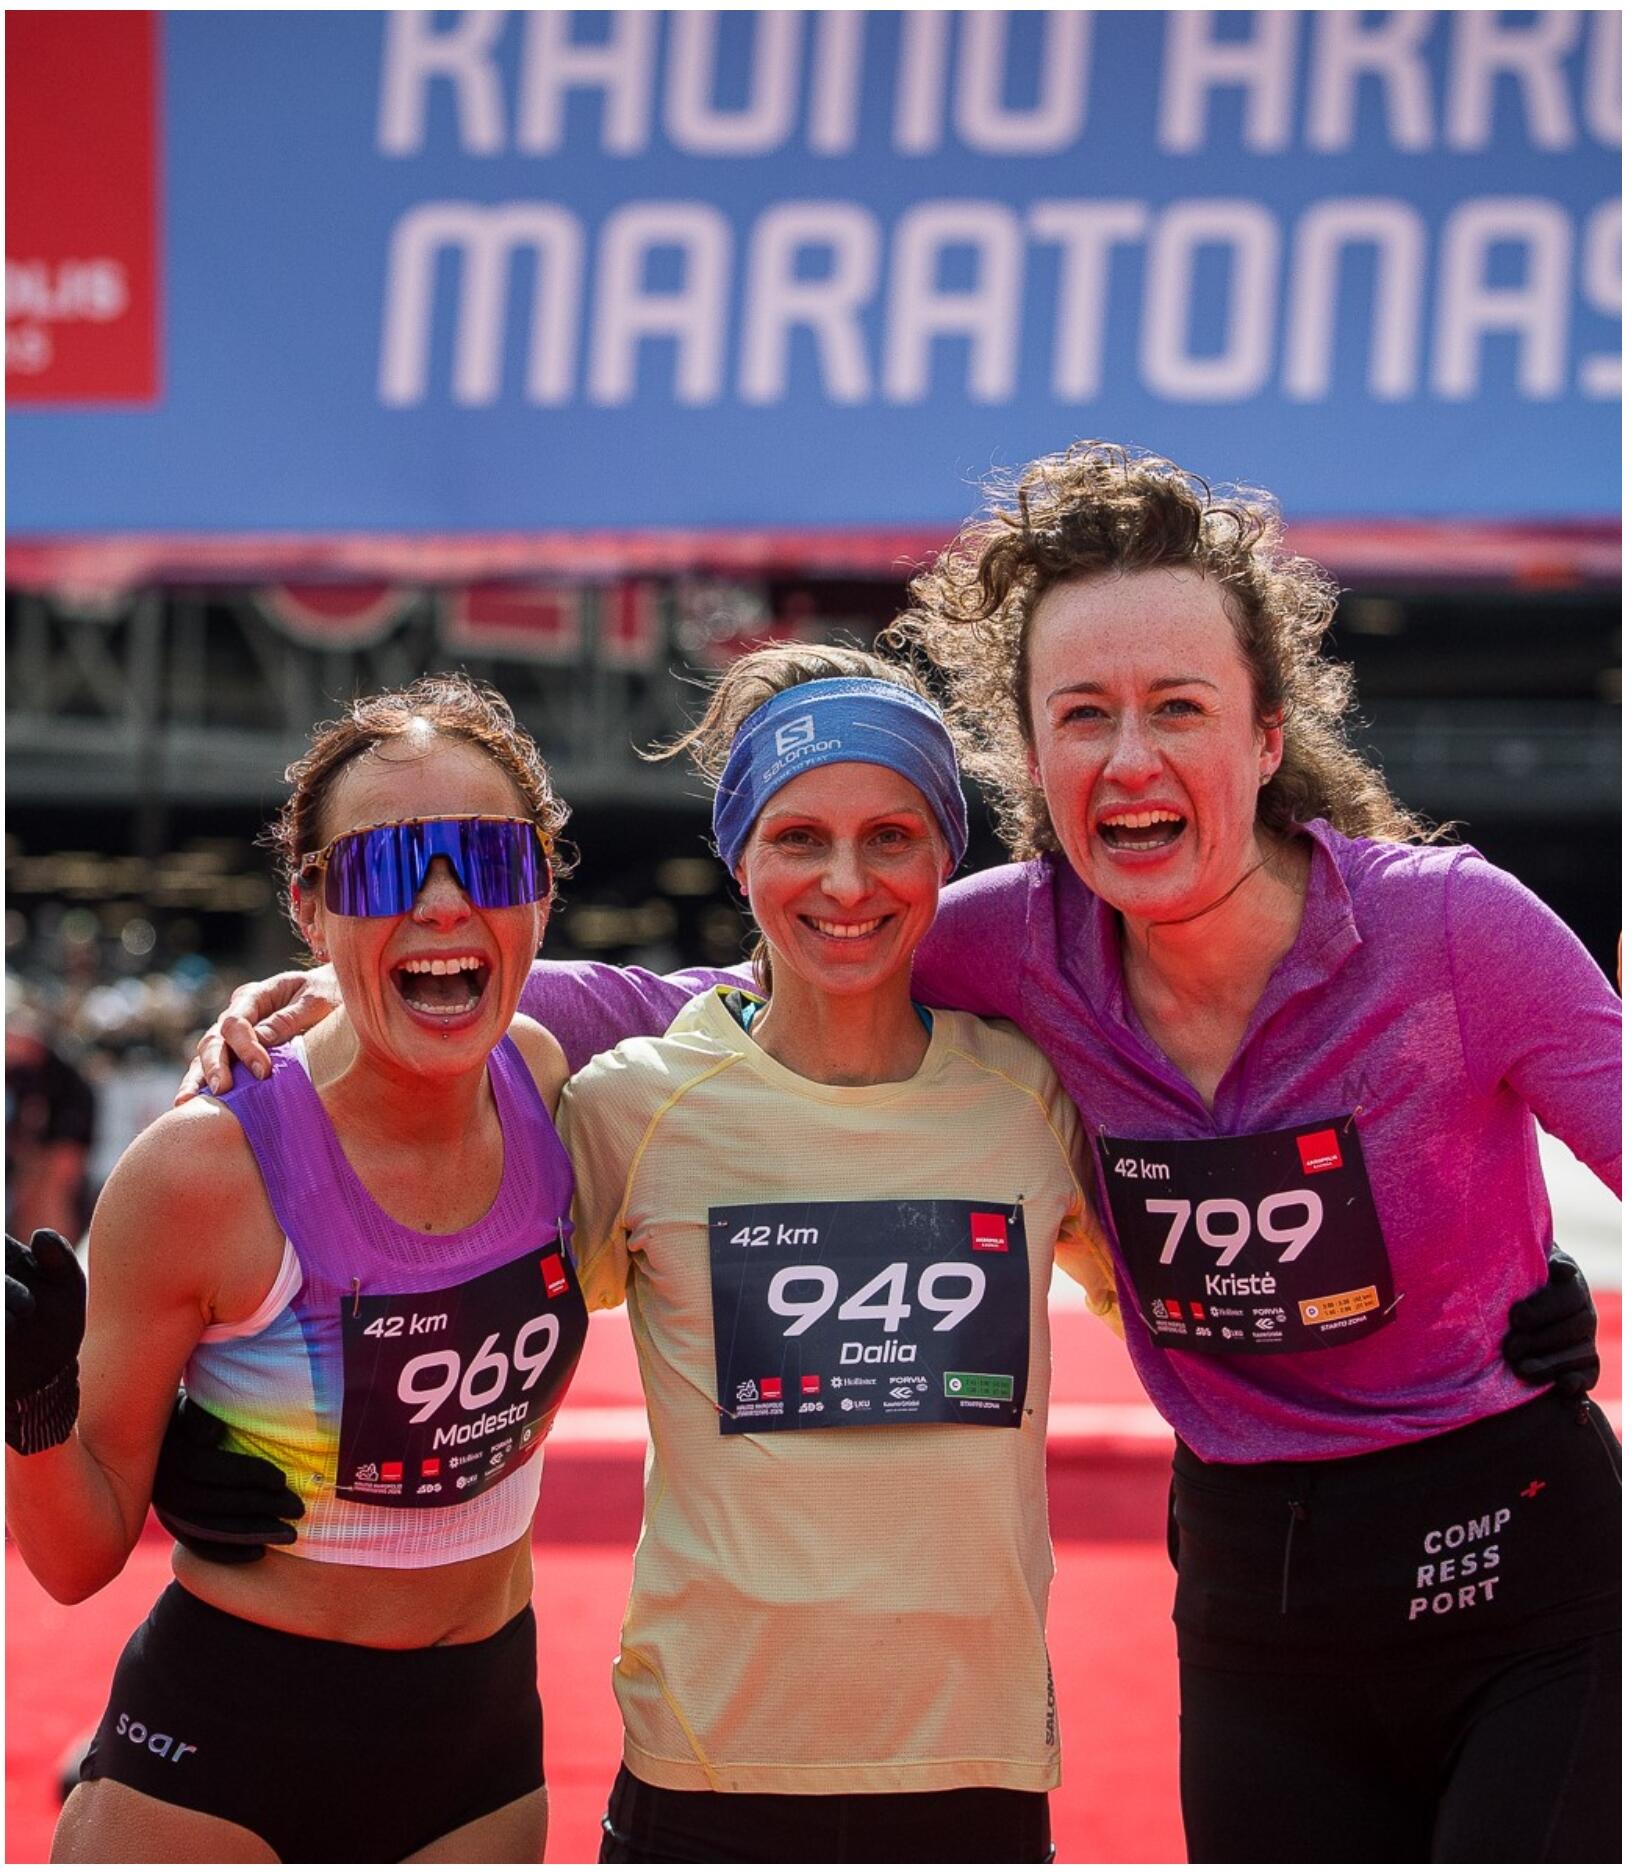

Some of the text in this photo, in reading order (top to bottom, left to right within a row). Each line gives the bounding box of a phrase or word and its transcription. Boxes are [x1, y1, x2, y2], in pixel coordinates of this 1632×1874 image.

[1114, 1158, 1170, 1180] 42 km
[730, 1224, 818, 1247] 42 km
[1145, 1189, 1324, 1267] 799
[767, 1261, 986, 1337] 949
[1204, 1271, 1276, 1297] Kristė
[363, 1312, 448, 1339] 42 km
[397, 1313, 560, 1425] 969
[839, 1339, 917, 1365] Dalia
[432, 1401, 530, 1450] Modesta
[1424, 1507, 1511, 1555] COMP
[1416, 1544, 1501, 1589] RESS
[1408, 1576, 1500, 1621] PORT
[116, 1713, 197, 1762] soar
